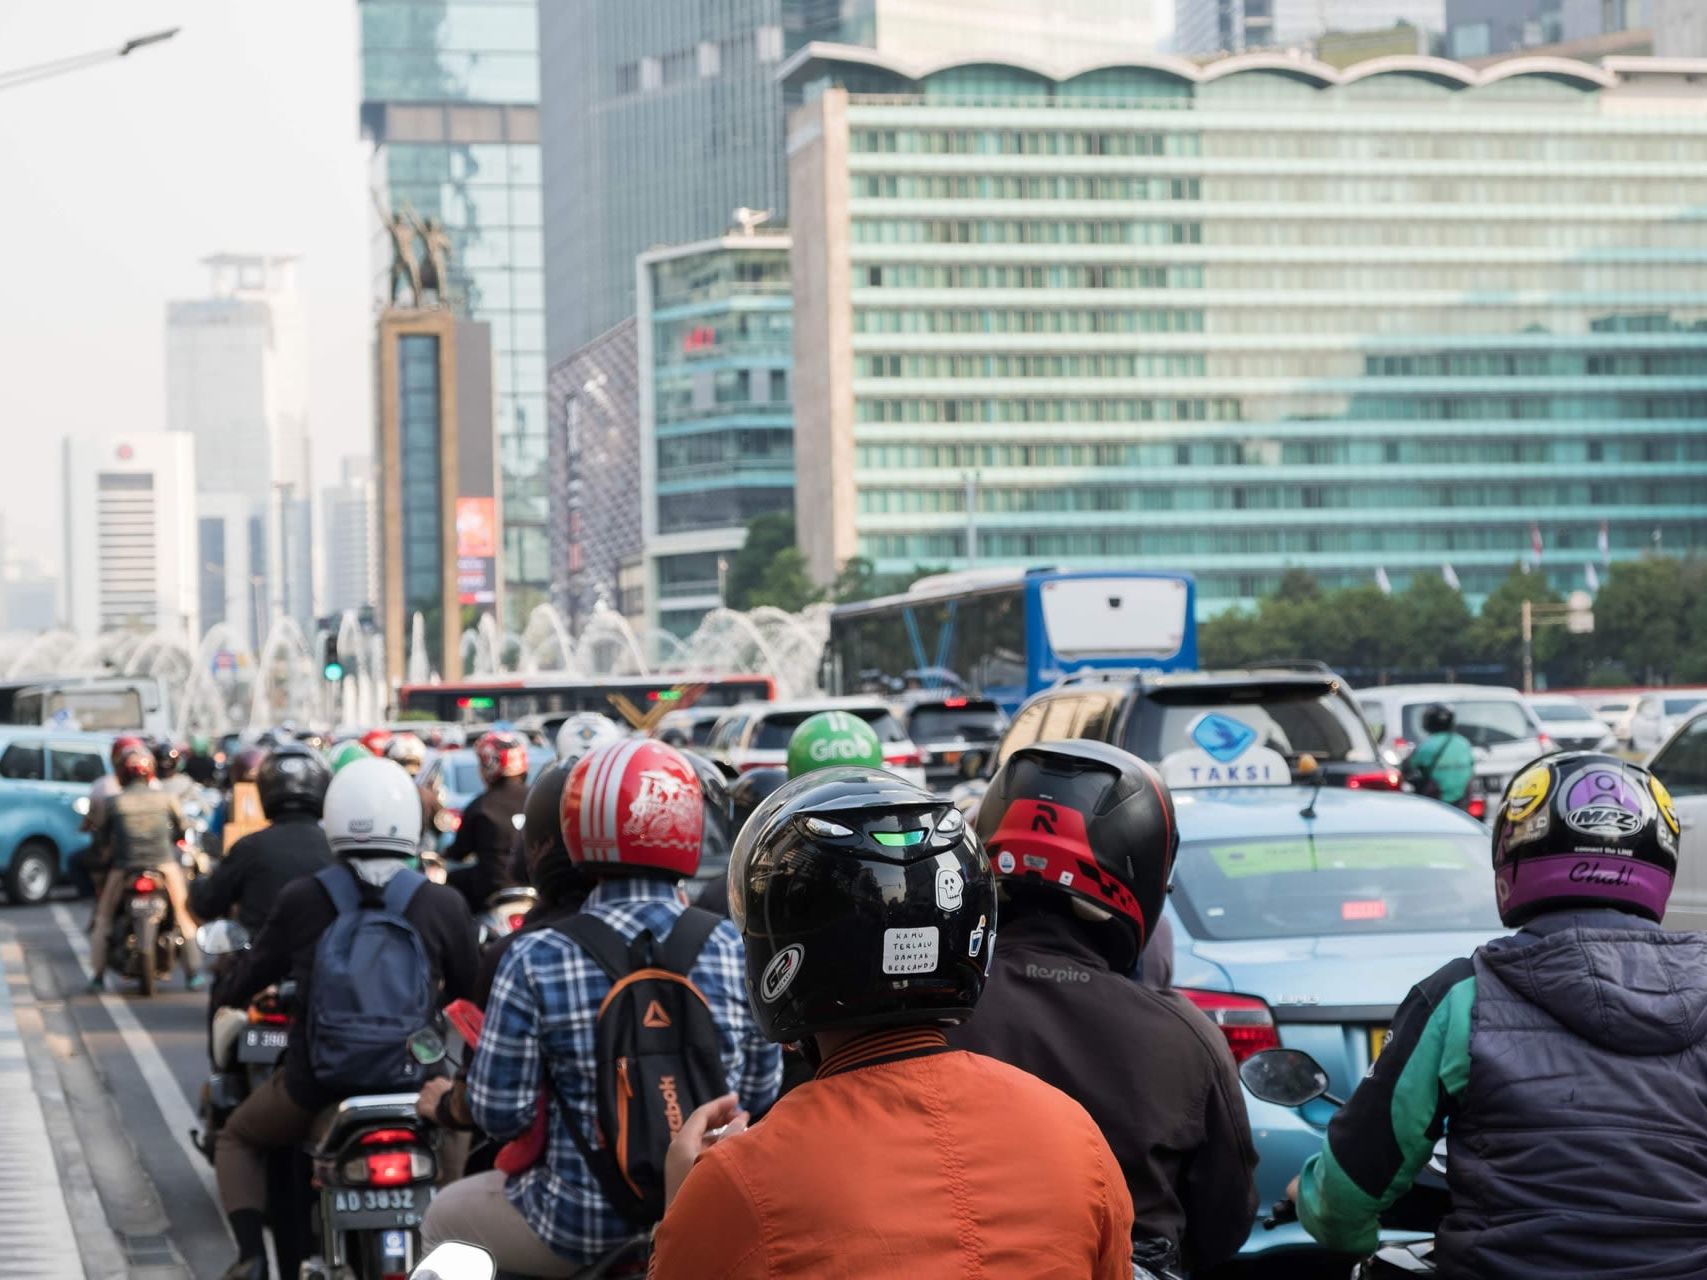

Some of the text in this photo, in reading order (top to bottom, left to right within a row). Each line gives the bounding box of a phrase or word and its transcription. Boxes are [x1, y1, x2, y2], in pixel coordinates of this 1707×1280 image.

[810, 733, 872, 762] Grab
[1189, 766, 1270, 780] TAKSI
[896, 932, 924, 940] KAMU
[893, 941, 932, 951] TERLALU
[1026, 963, 1091, 983] Respiro
[658, 1076, 683, 1140] ebok
